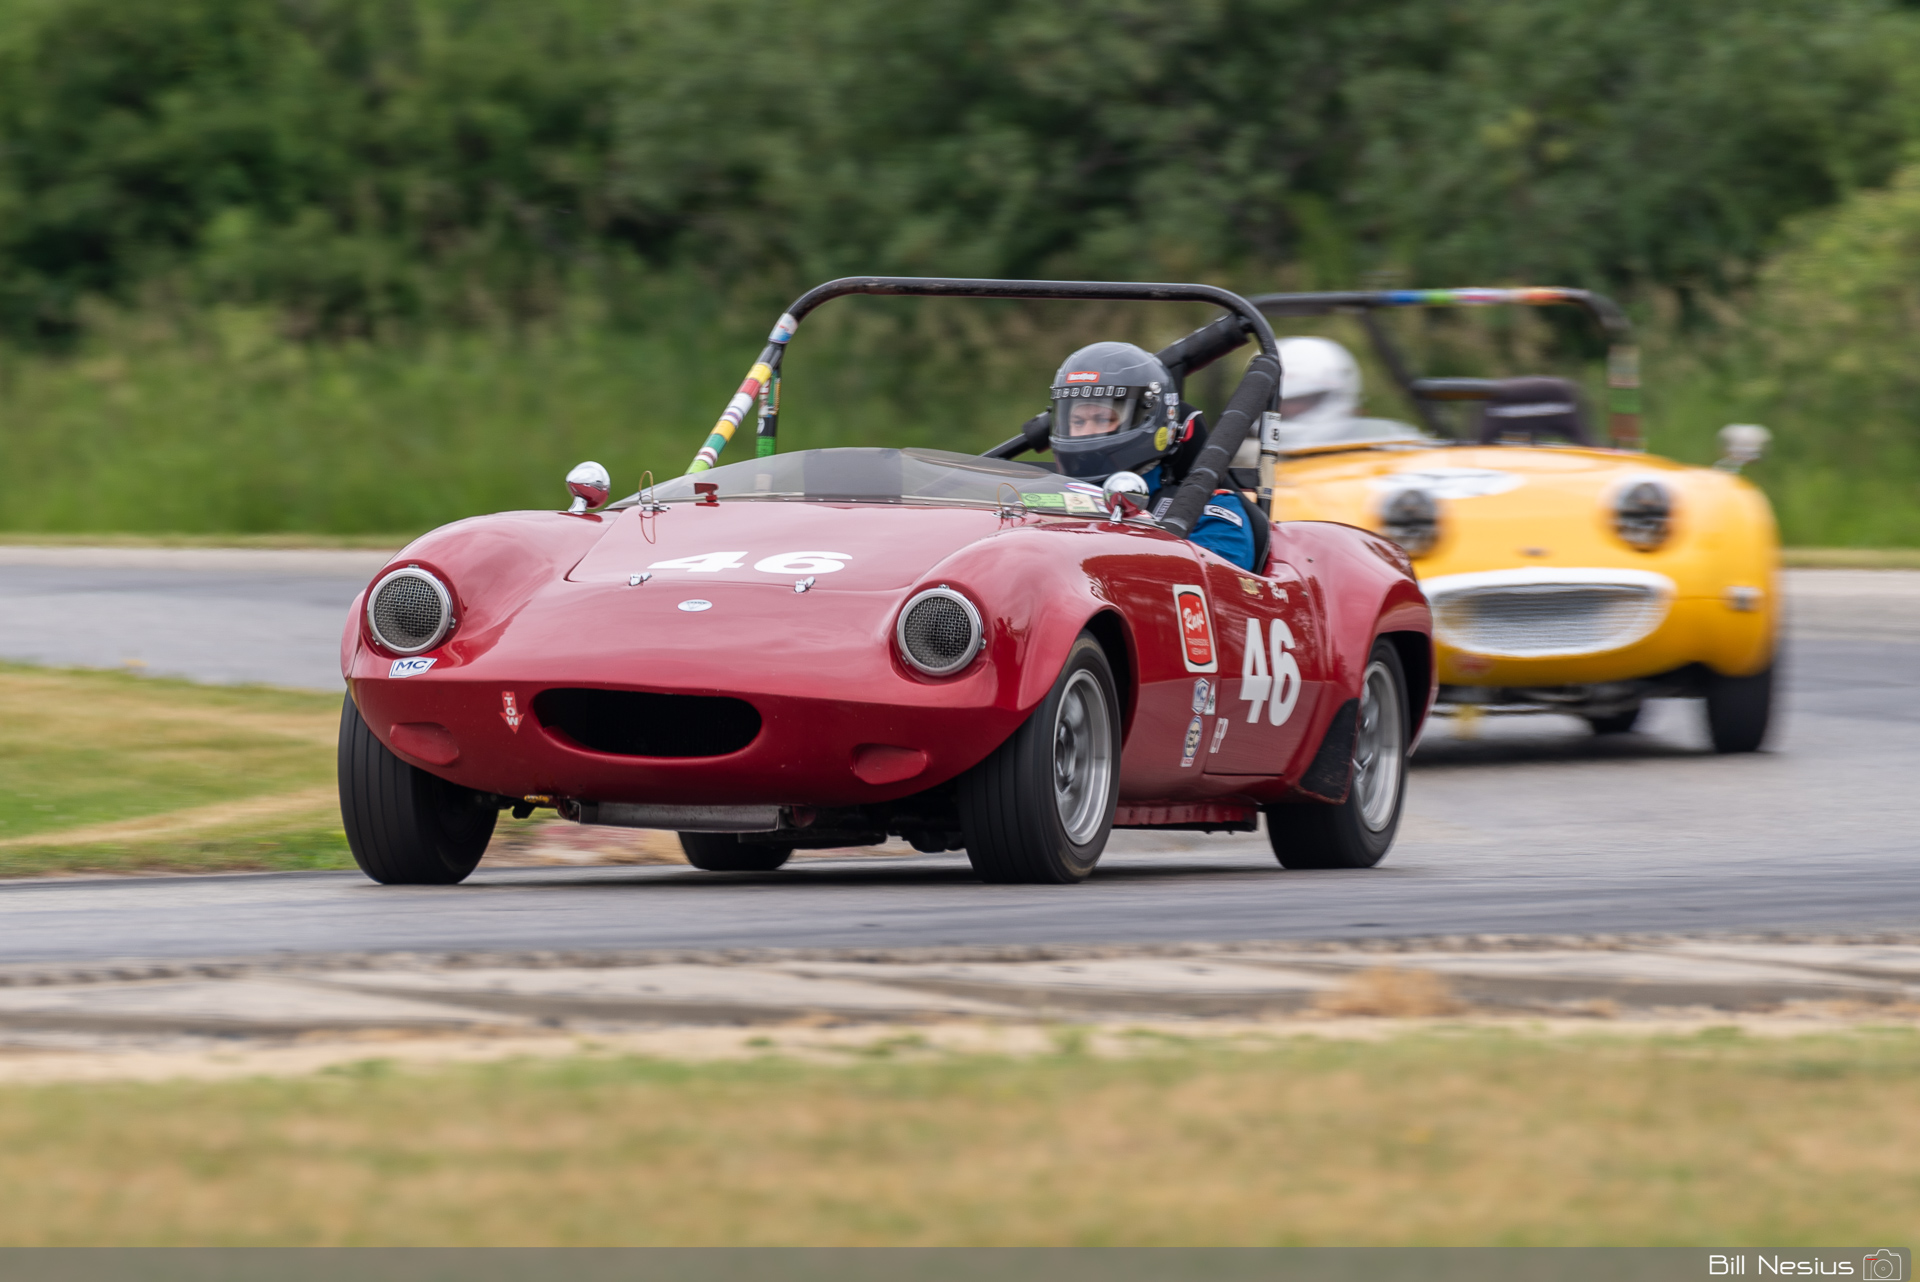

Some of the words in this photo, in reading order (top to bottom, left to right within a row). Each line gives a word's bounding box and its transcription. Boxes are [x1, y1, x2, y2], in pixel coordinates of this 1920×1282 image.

[647, 551, 853, 574] 46
[395, 660, 428, 671] MC
[1239, 618, 1302, 726] 46
[504, 696, 518, 726] TOW
